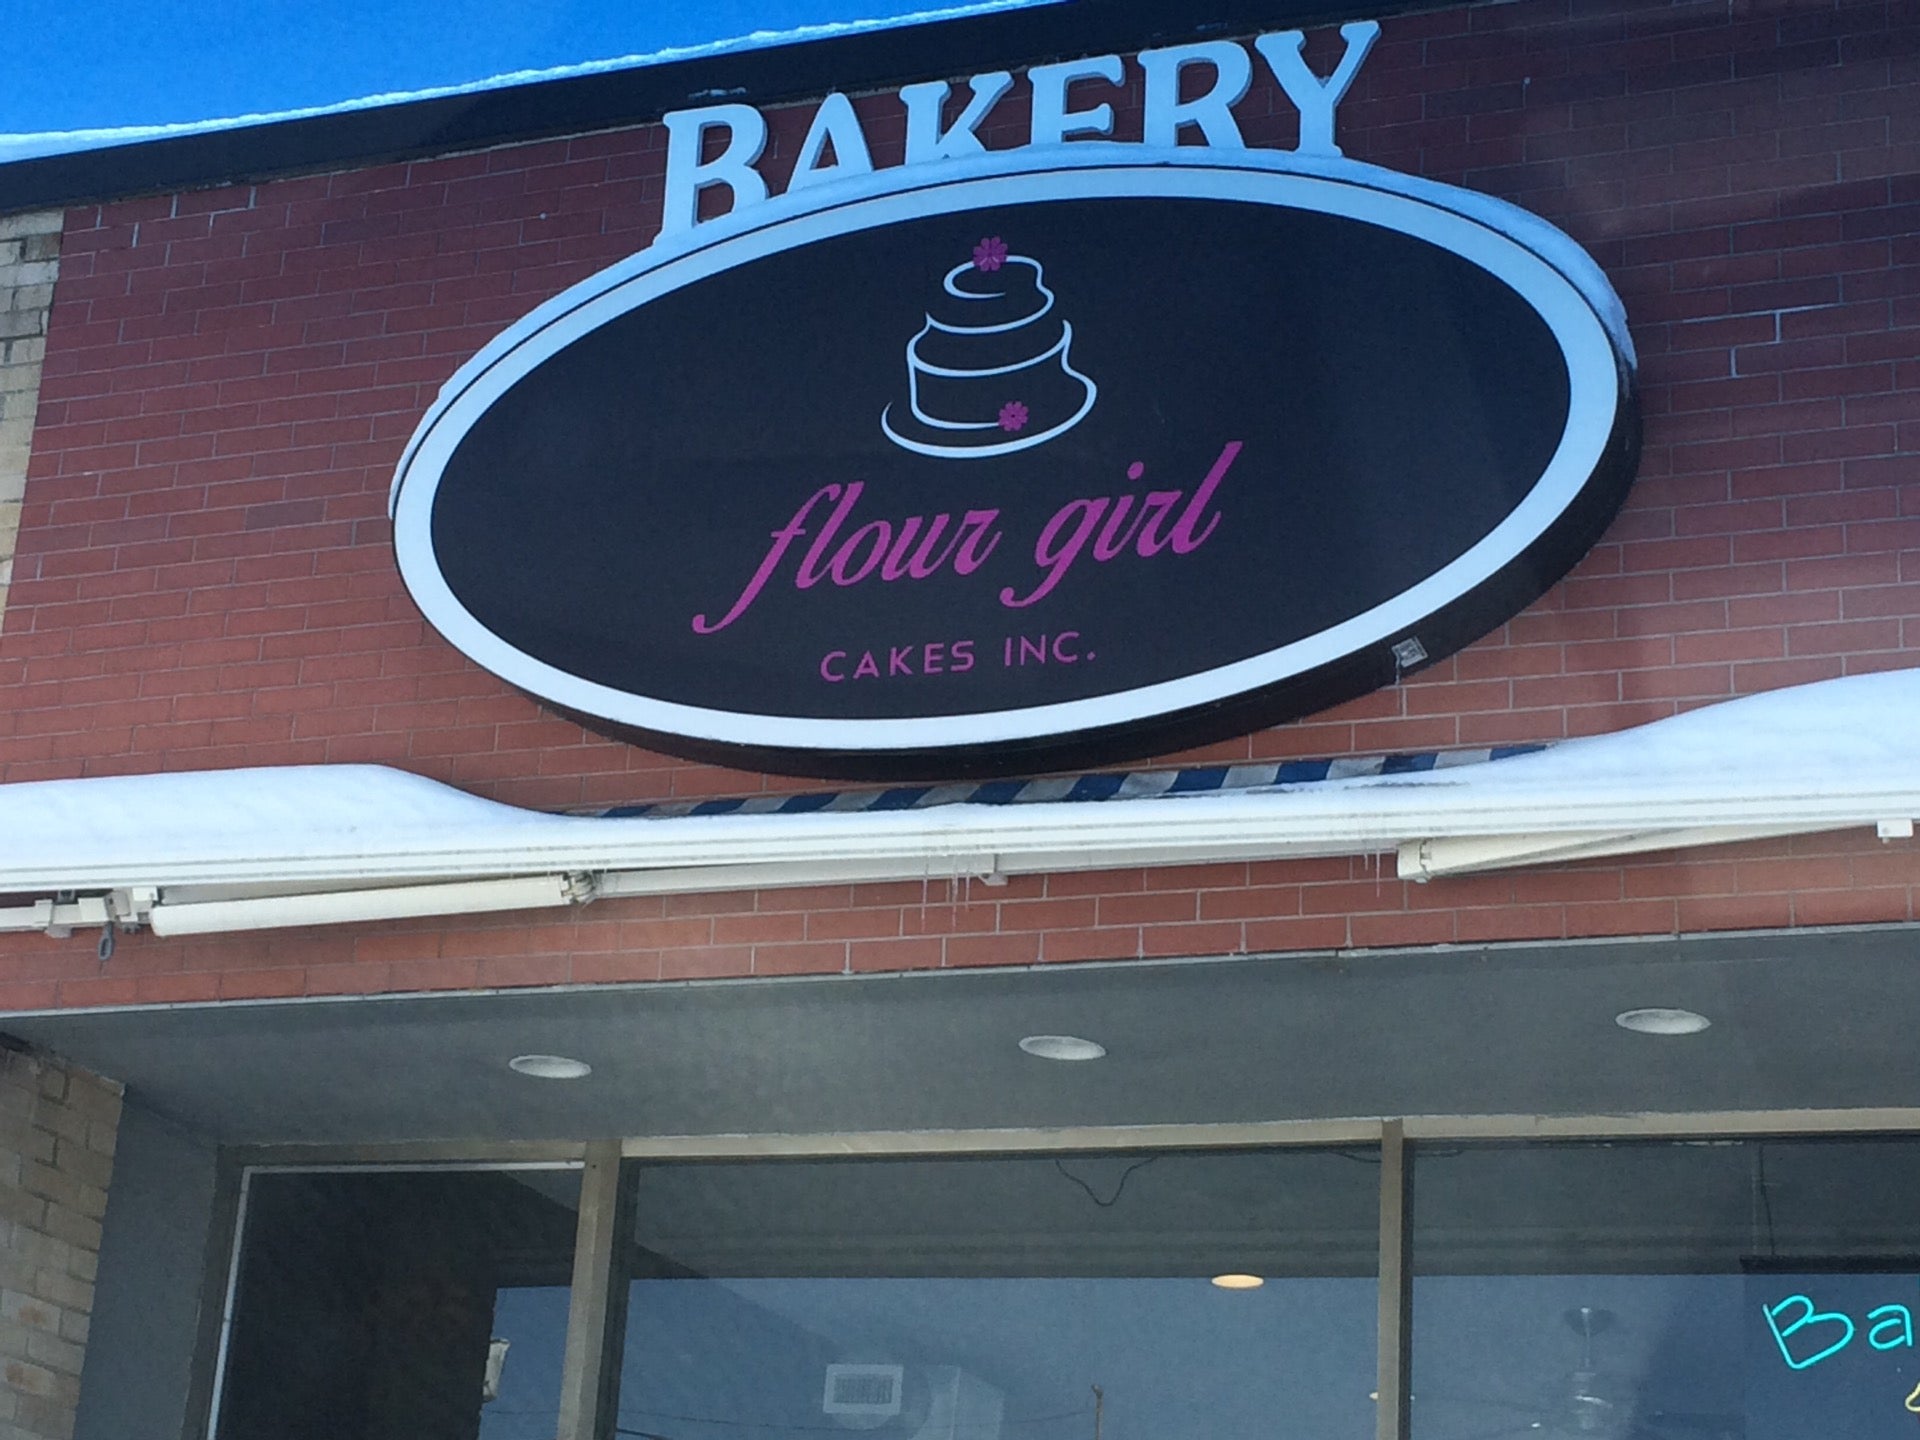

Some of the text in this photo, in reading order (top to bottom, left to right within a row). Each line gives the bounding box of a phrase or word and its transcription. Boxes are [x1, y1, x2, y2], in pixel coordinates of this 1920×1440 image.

[652, 20, 1381, 247] BAKERY
[692, 441, 1243, 634] flour girl
[820, 631, 1097, 682] CAKES INC.
